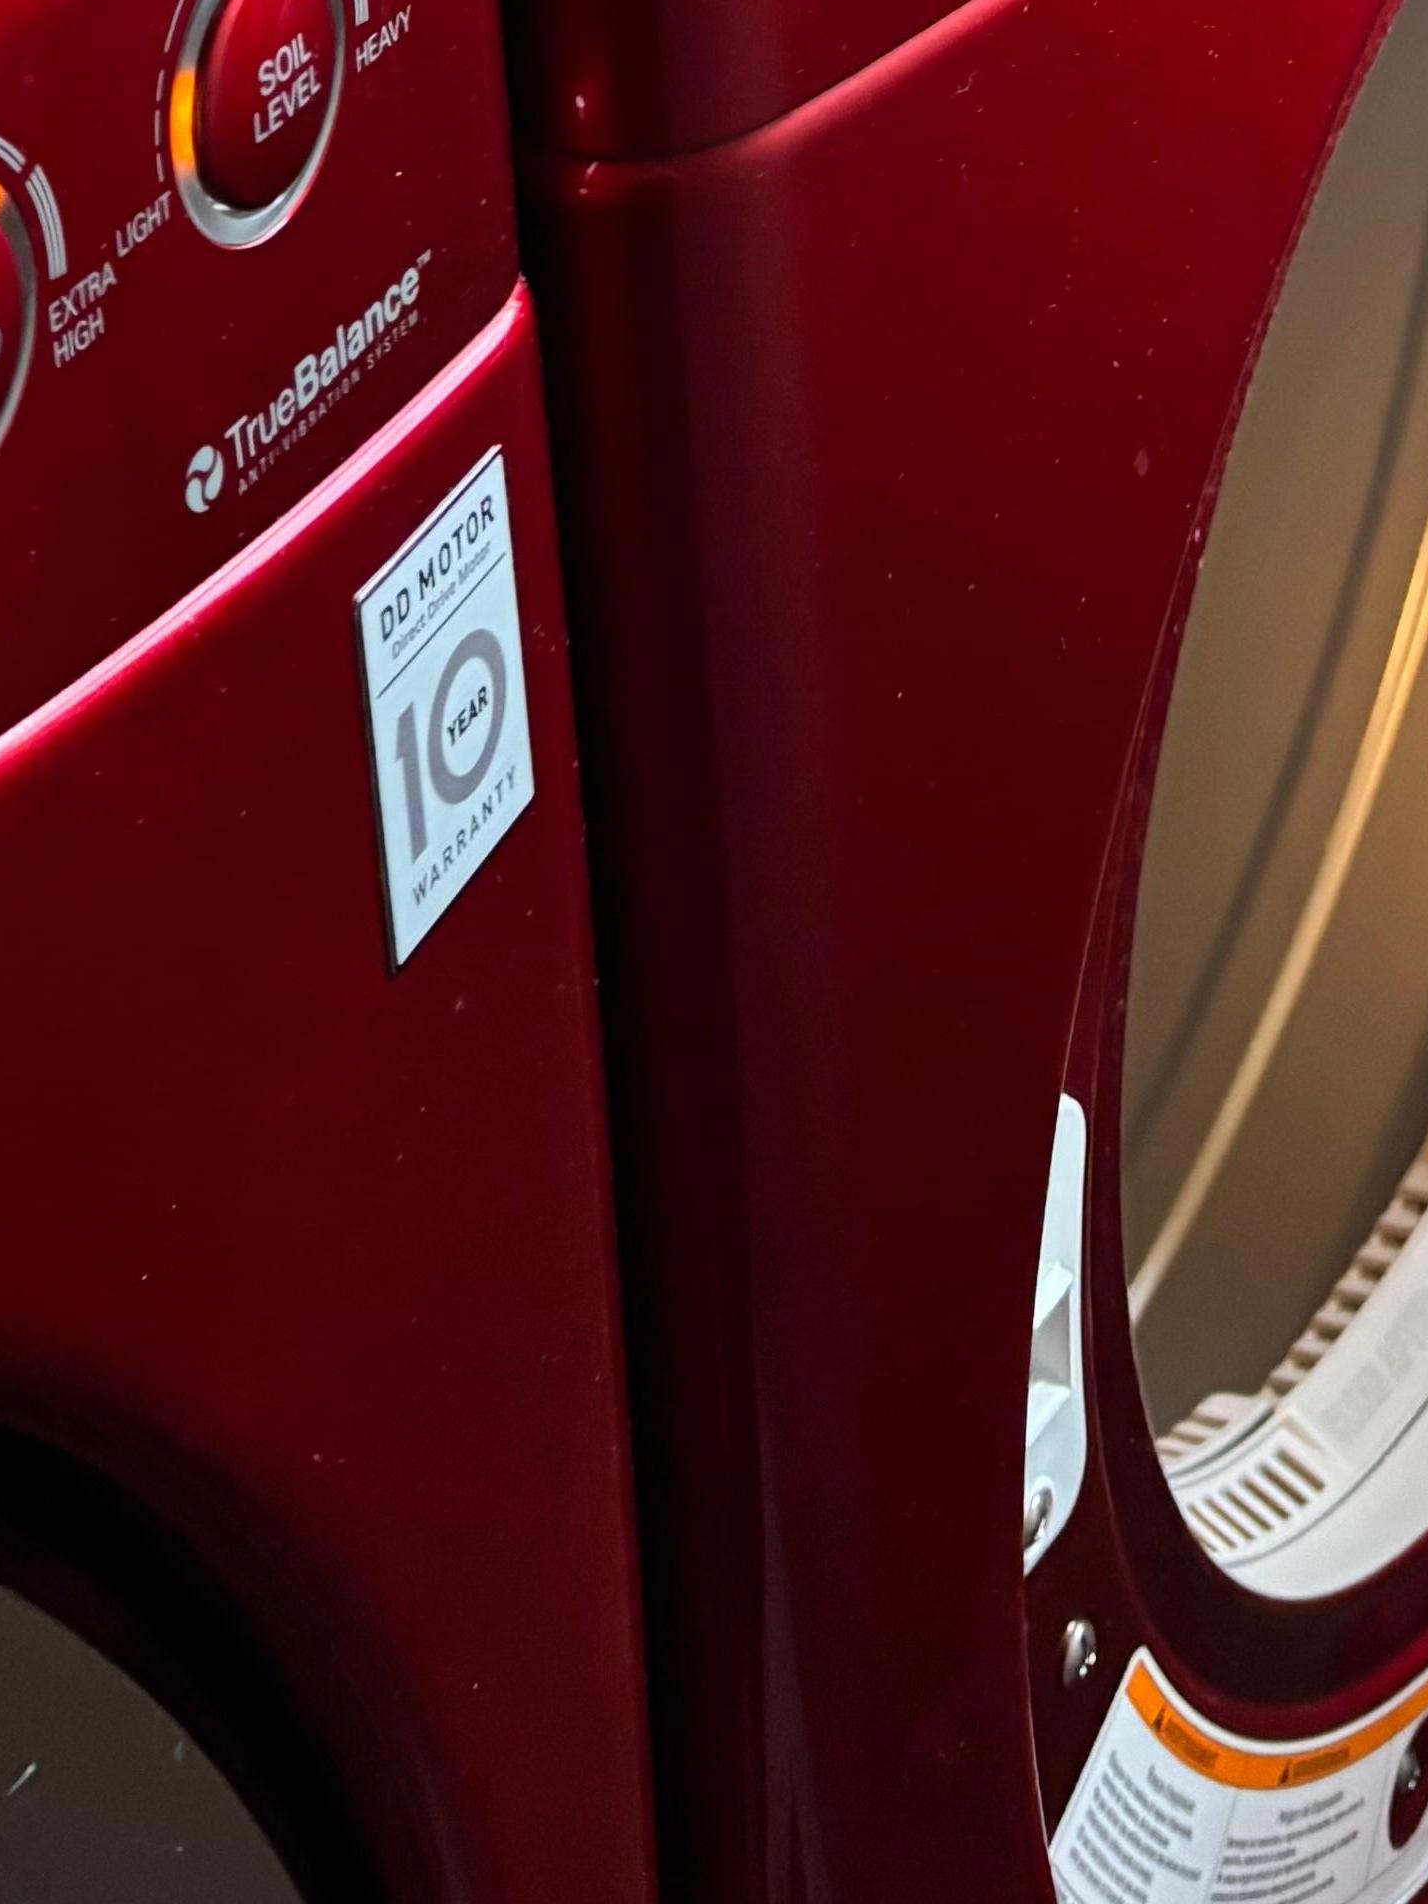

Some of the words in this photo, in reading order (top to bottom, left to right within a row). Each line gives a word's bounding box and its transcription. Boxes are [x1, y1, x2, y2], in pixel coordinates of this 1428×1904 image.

[257, 32, 313, 97] SOIL
[355, 4, 412, 73] HEAVY
[254, 64, 322, 144] LEVEL
[115, 190, 173, 259] LIGHT
[48, 261, 118, 334] EXTRA
[53, 307, 106, 368] HIGH
[365, 308, 420, 371] SYSTEM
[380, 586, 411, 643] DD
[417, 493, 495, 591] MOTOR
[391, 612, 427, 661] Direct
[427, 580, 456, 622] Drive
[458, 539, 492, 587] Motor
[394, 628, 507, 865] 10
[446, 683, 489, 748] YEAR
[411, 763, 518, 907] WARRANTY
